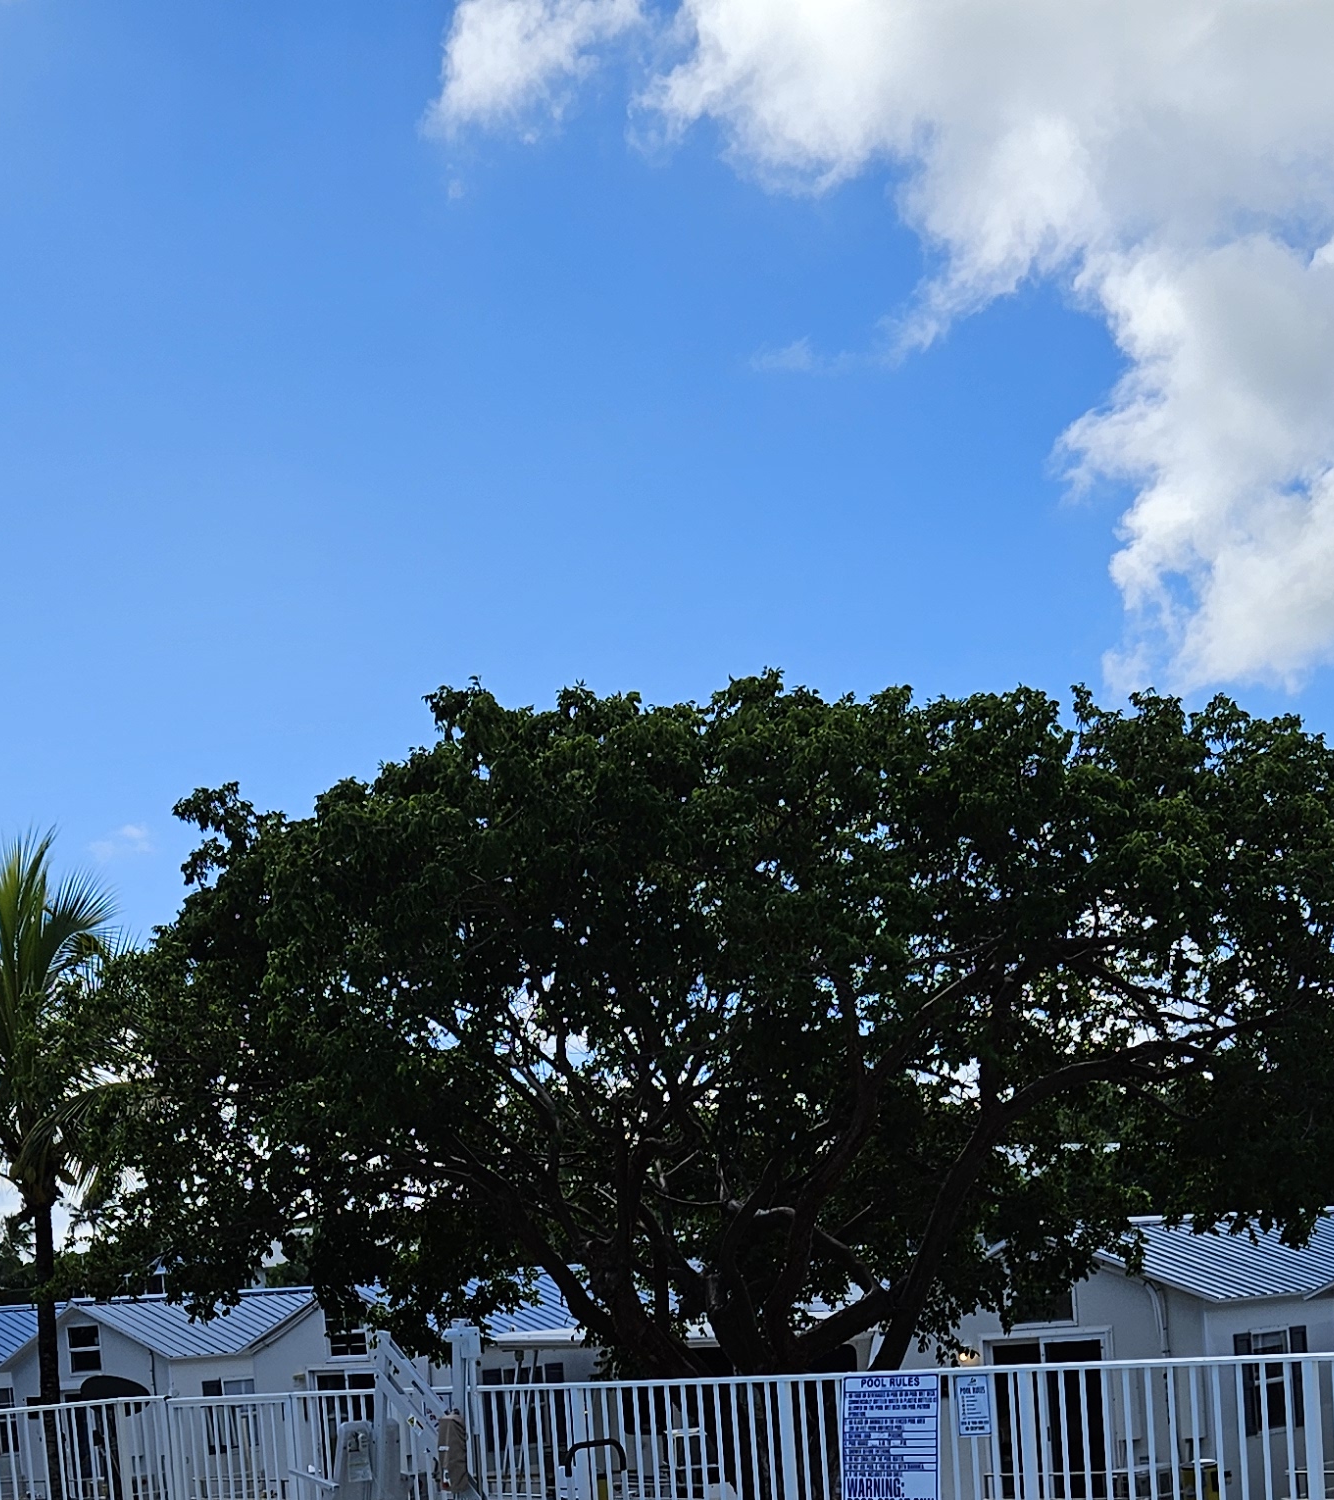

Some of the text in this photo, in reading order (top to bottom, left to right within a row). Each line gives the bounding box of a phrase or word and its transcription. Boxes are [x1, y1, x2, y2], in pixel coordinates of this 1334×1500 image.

[861, 1376, 920, 1388] POOL RULES
[847, 1478, 905, 1498] WARNING:
